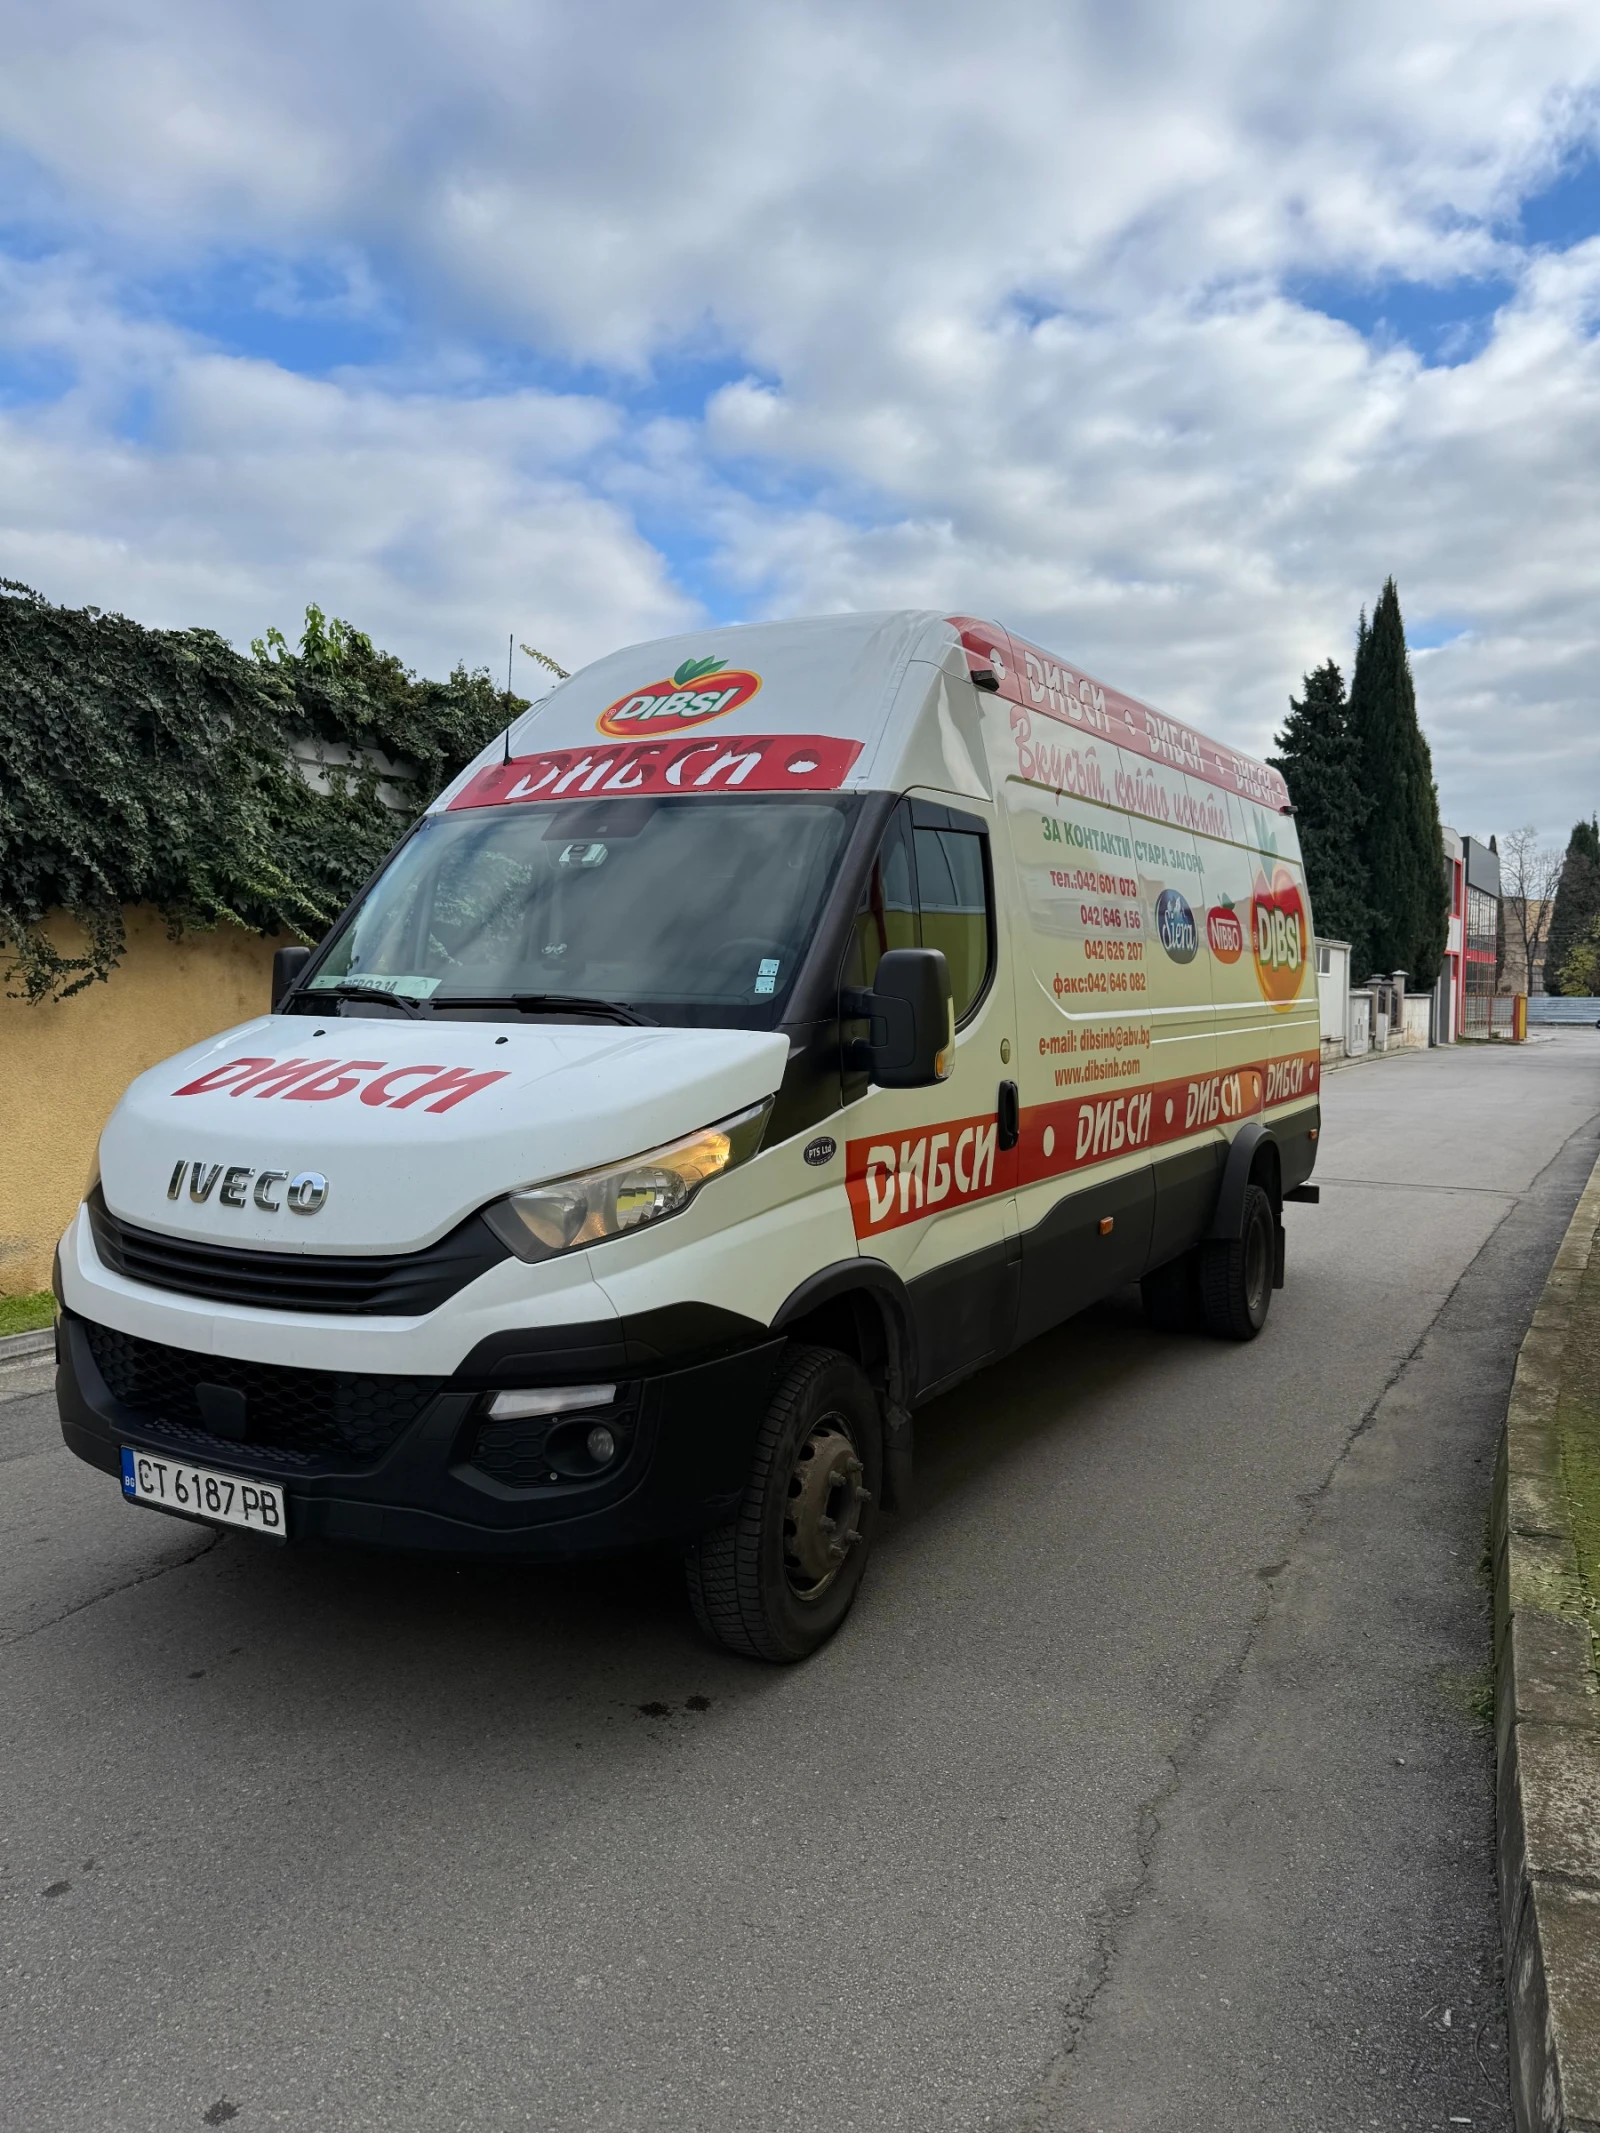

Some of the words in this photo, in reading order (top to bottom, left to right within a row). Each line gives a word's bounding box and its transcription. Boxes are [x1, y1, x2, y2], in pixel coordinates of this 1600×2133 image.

[611, 687, 740, 722] DIBSI
[1041, 816, 1062, 844] ЗА
[1064, 822, 1132, 859] КОНТАКТИ
[1134, 840, 1169, 867] СТАРА
[1170, 848, 1205, 876] ЗАГОРА
[1119, 877, 1137, 898] 073
[1123, 910, 1141, 929] 156
[1209, 916, 1240, 951] NIBBO
[1257, 903, 1302, 971] DIBSI
[1126, 942, 1143, 961] 207
[1129, 972, 1146, 992] 082
[1038, 1028, 1077, 1056] e-mail:
[1054, 1058, 1141, 1087] www.dibsinb.com
[808, 1147, 821, 1159] PTS
[167, 1160, 329, 1216] IVECO
[125, 1475, 135, 1488] BG
[175, 1469, 235, 1515] 6187
